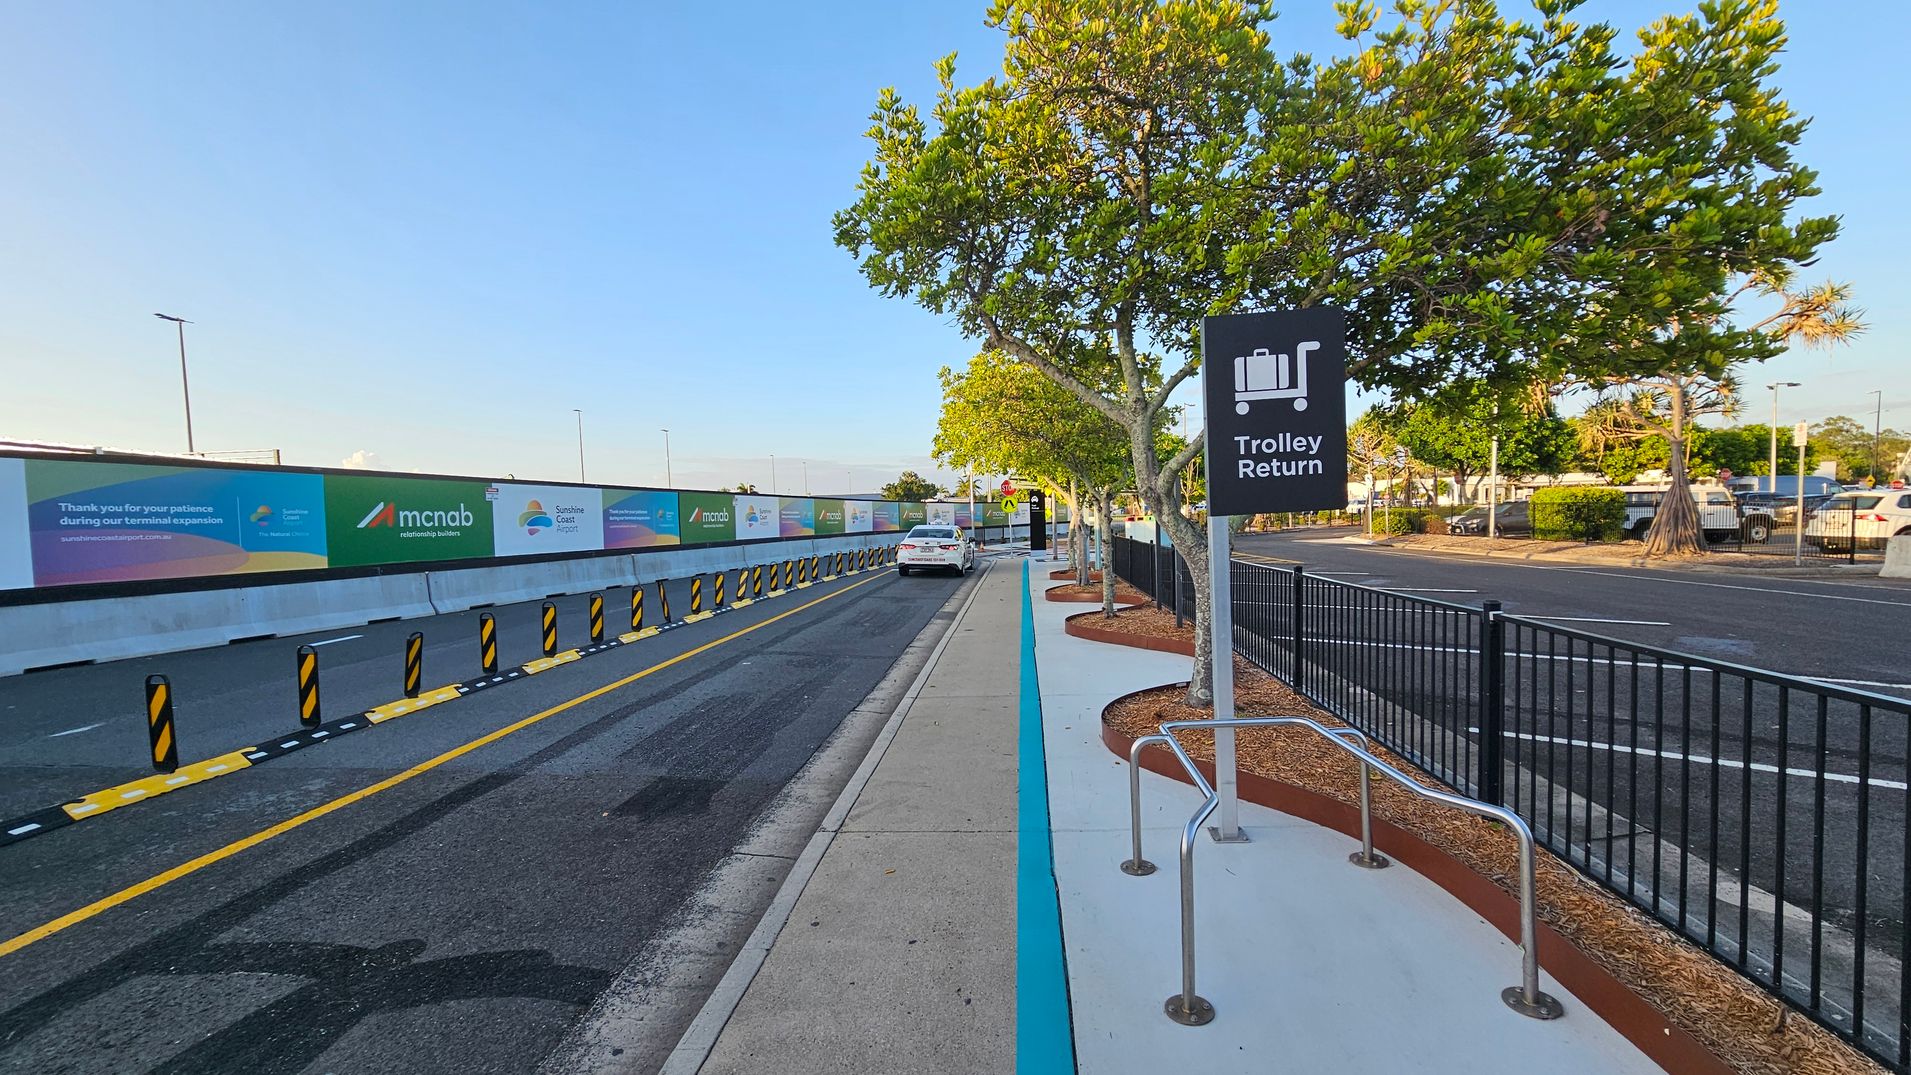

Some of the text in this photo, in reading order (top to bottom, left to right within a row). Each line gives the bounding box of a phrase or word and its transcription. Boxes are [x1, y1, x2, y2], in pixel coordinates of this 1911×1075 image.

[1234, 432, 1323, 455] Trolley
[1238, 459, 1323, 479] Return
[58, 502, 214, 514] Thank you for your patience
[555, 504, 585, 514] Sunshine
[399, 503, 473, 527] mcnab
[556, 514, 575, 524] Coast
[702, 507, 729, 522] mcnab
[60, 516, 101, 527] during
[124, 516, 172, 525] terminal
[173, 516, 224, 526] expansion
[400, 530, 437, 538] relationship
[556, 524, 578, 534] Airport
[61, 534, 172, 542] sunshinecoastairport.com.au
